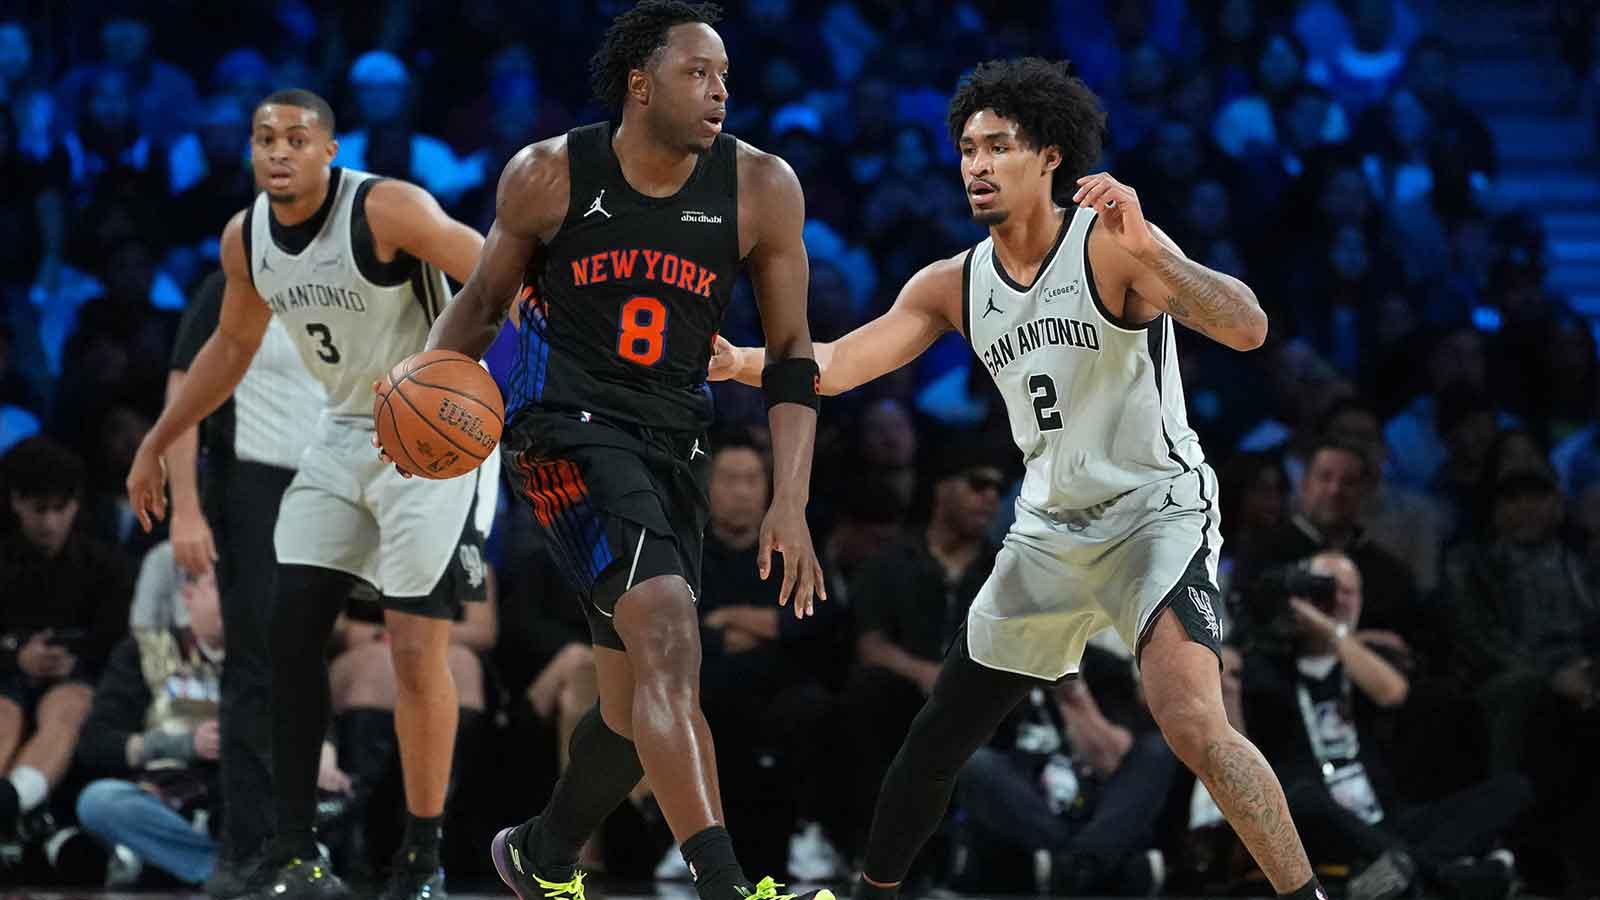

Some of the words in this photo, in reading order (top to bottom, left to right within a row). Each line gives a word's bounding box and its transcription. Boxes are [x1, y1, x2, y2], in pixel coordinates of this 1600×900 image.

[267, 295, 288, 313] AN
[288, 283, 366, 313] ANTONIO
[571, 249, 639, 286] NEW
[642, 249, 718, 298] YORK
[1049, 285, 1075, 298] LEDGER
[305, 322, 341, 364] 3
[616, 296, 669, 367] 8
[984, 333, 1016, 377] SAN
[1016, 317, 1100, 356] ANTONIO
[1028, 373, 1064, 432] 2
